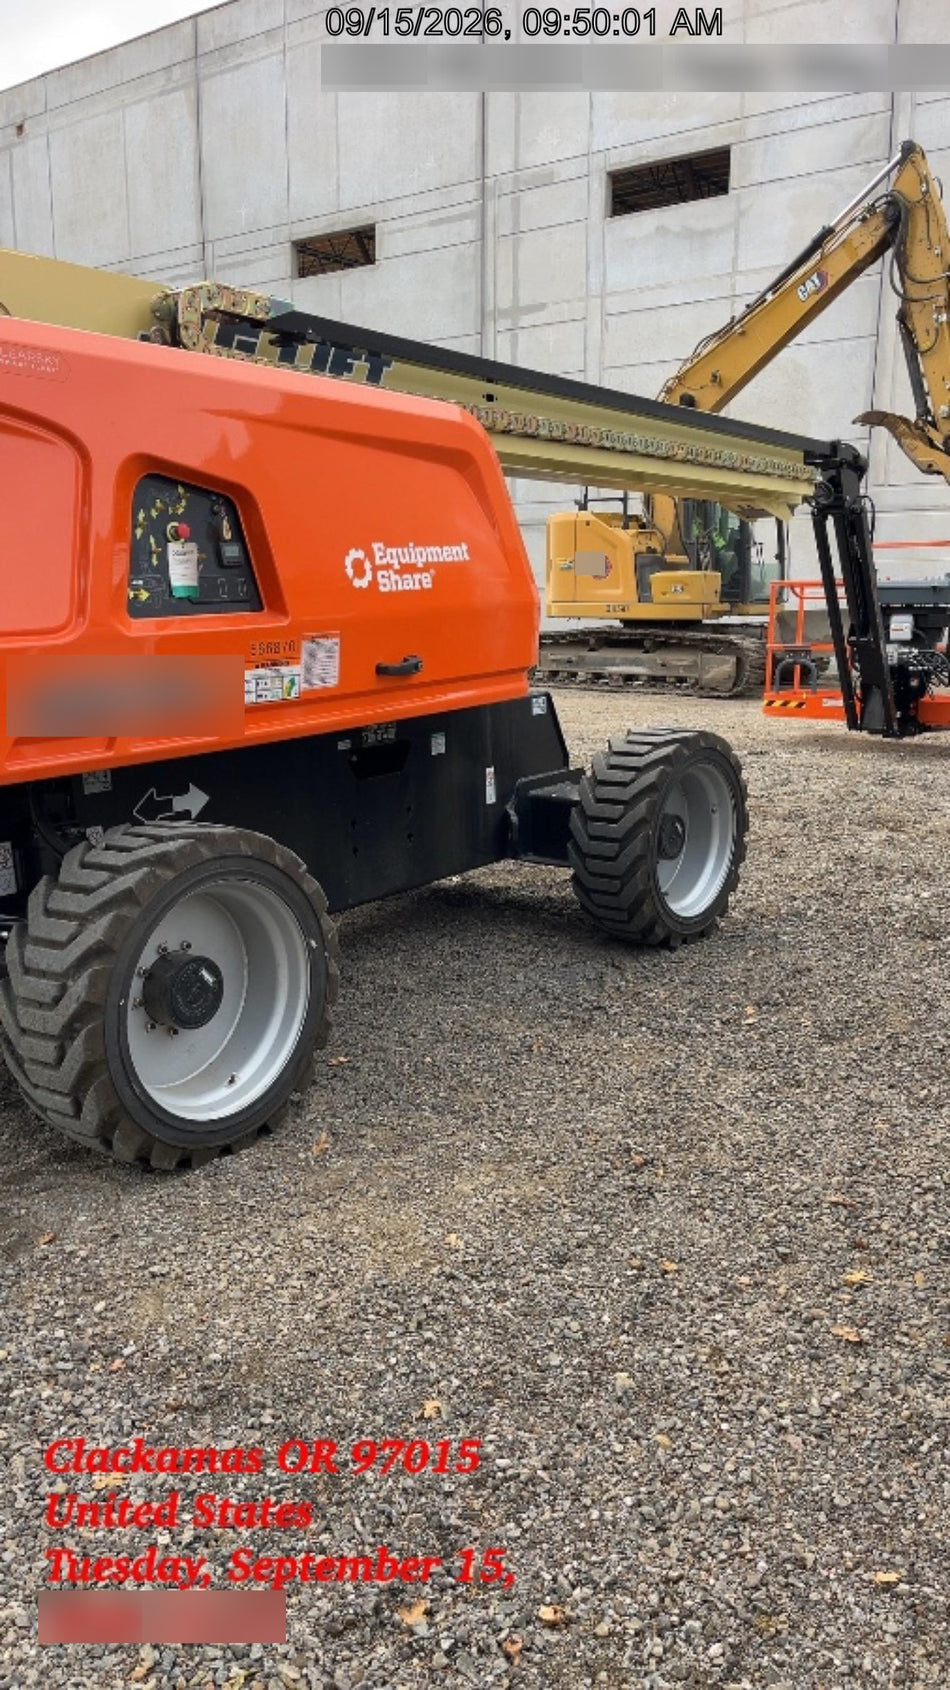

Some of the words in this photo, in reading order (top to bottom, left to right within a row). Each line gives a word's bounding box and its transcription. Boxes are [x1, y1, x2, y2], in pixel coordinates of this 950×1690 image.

[797, 271, 821, 301] CAT
[371, 541, 470, 569] Equipment
[376, 568, 433, 592] Share
